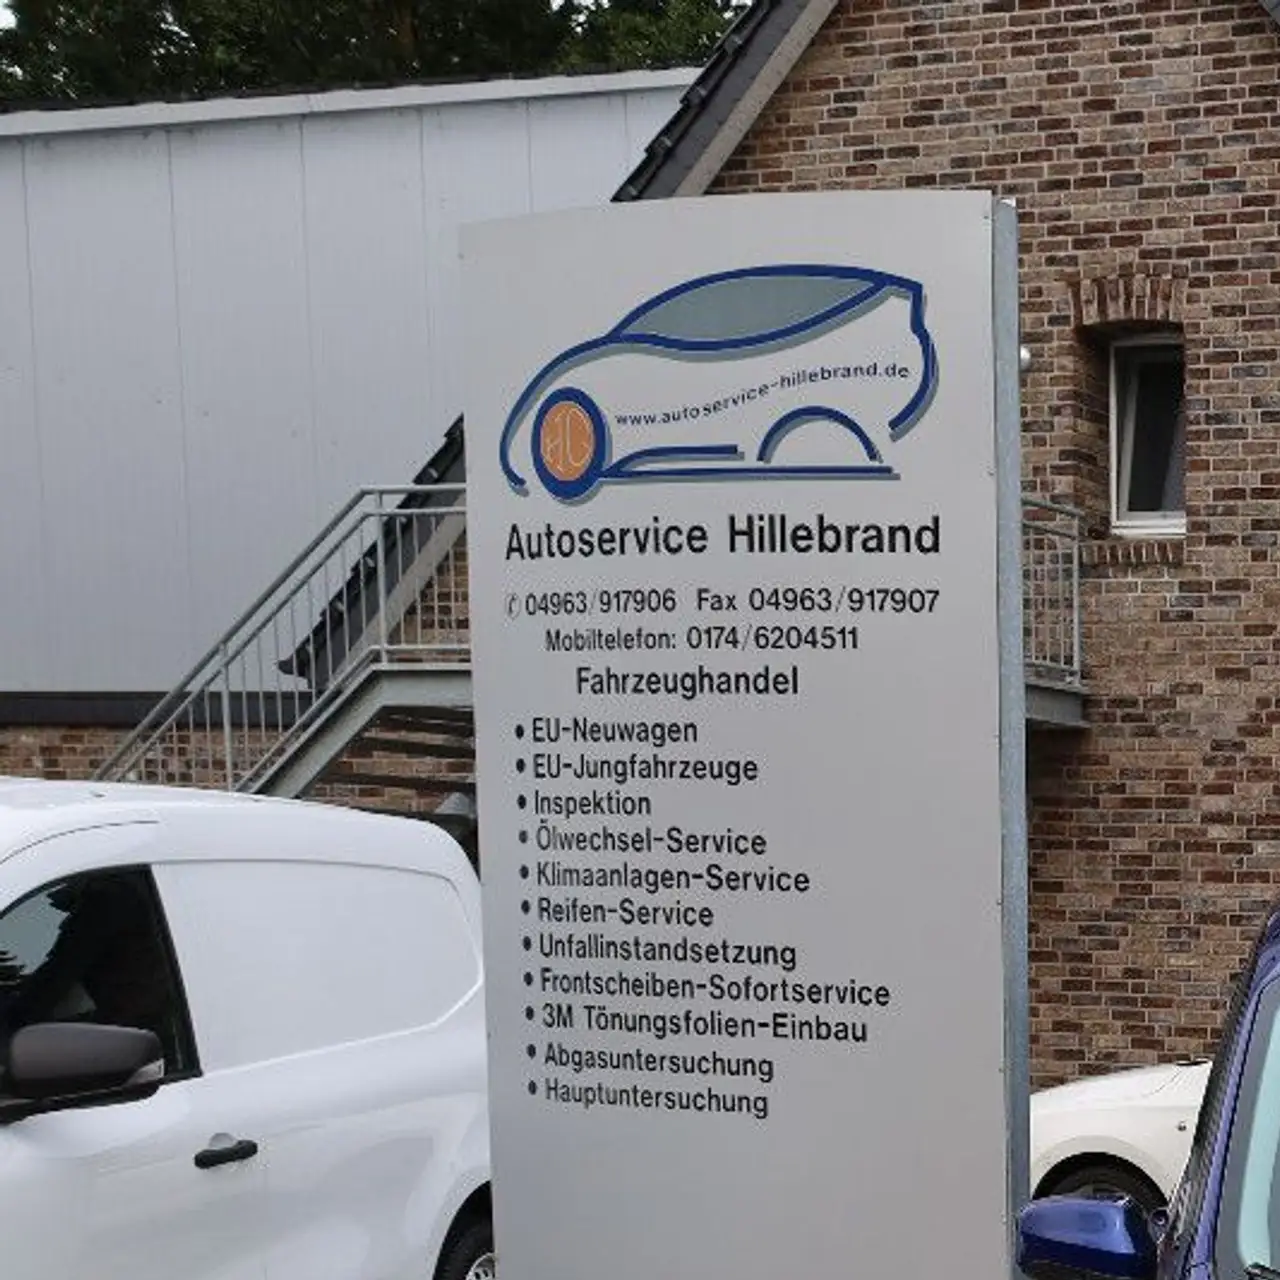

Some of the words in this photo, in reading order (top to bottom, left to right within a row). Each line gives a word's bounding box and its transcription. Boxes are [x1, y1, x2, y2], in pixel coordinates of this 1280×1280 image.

[614, 362, 910, 425] www.autoservice-hillebrand.de
[505, 516, 709, 561] Autoservice
[728, 514, 942, 555] Hillebrand
[696, 588, 738, 612] Fax
[545, 627, 677, 652] Mobiltelefon:
[576, 665, 800, 700] Fahrzeughandel
[532, 718, 699, 746] EU-Neuwagen
[533, 754, 759, 785] EU-Jungfahrzeuge
[534, 790, 652, 818] Inspektion
[537, 819, 768, 856] Ölwechsel-Service
[537, 863, 810, 893] Klimaanlagen-Service
[538, 899, 715, 927] Reifen-Service
[539, 933, 797, 970] Unfallinstandsetzung
[540, 968, 891, 1007] Frontscheiben-Sofortservice
[542, 1006, 573, 1031] 3M
[583, 1005, 868, 1043] Tönungsfolien-Einbau
[545, 1044, 774, 1082] Abgasuntersuchung
[545, 1080, 768, 1118] Hauptuntersuchung
